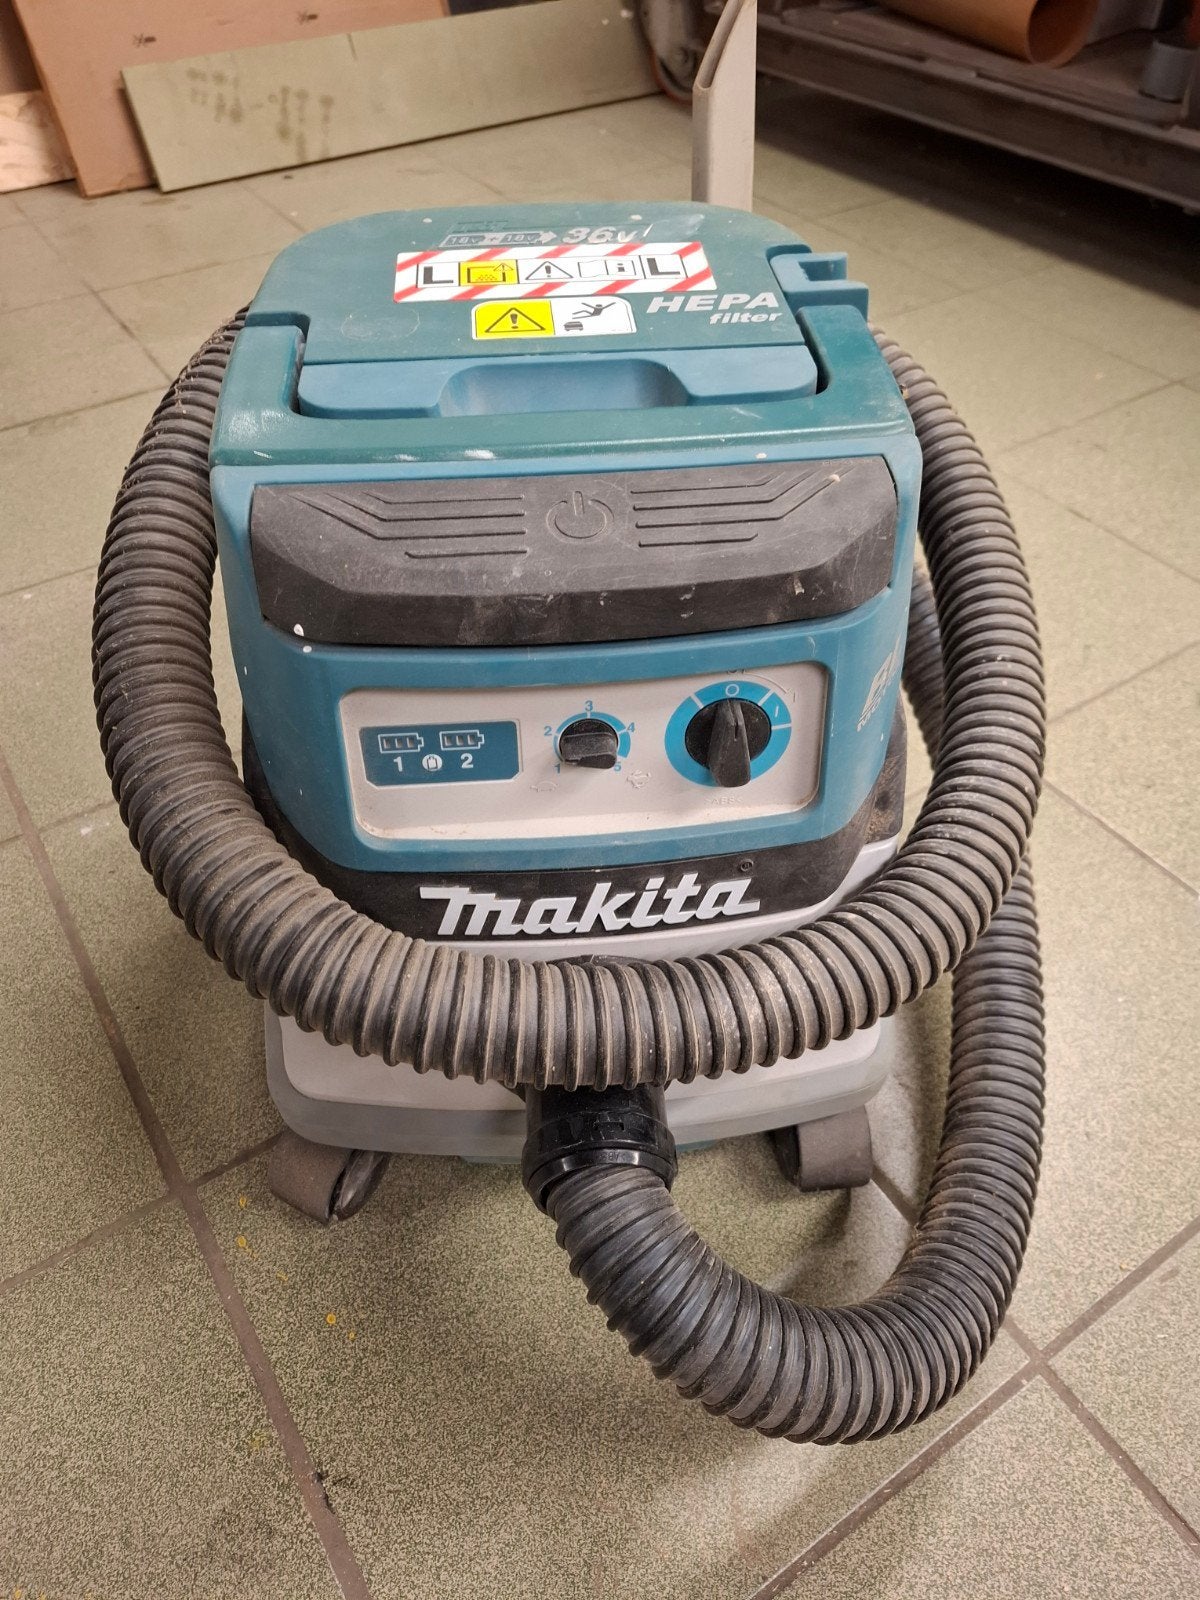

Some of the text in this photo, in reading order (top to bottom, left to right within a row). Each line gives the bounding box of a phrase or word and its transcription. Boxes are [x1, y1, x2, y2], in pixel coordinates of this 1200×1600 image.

[423, 257, 681, 285] L L
[646, 292, 779, 313] HEPA
[709, 313, 782, 325] filter
[584, 700, 594, 712] 3
[543, 722, 636, 737] 2 4
[393, 753, 474, 772] 1 2
